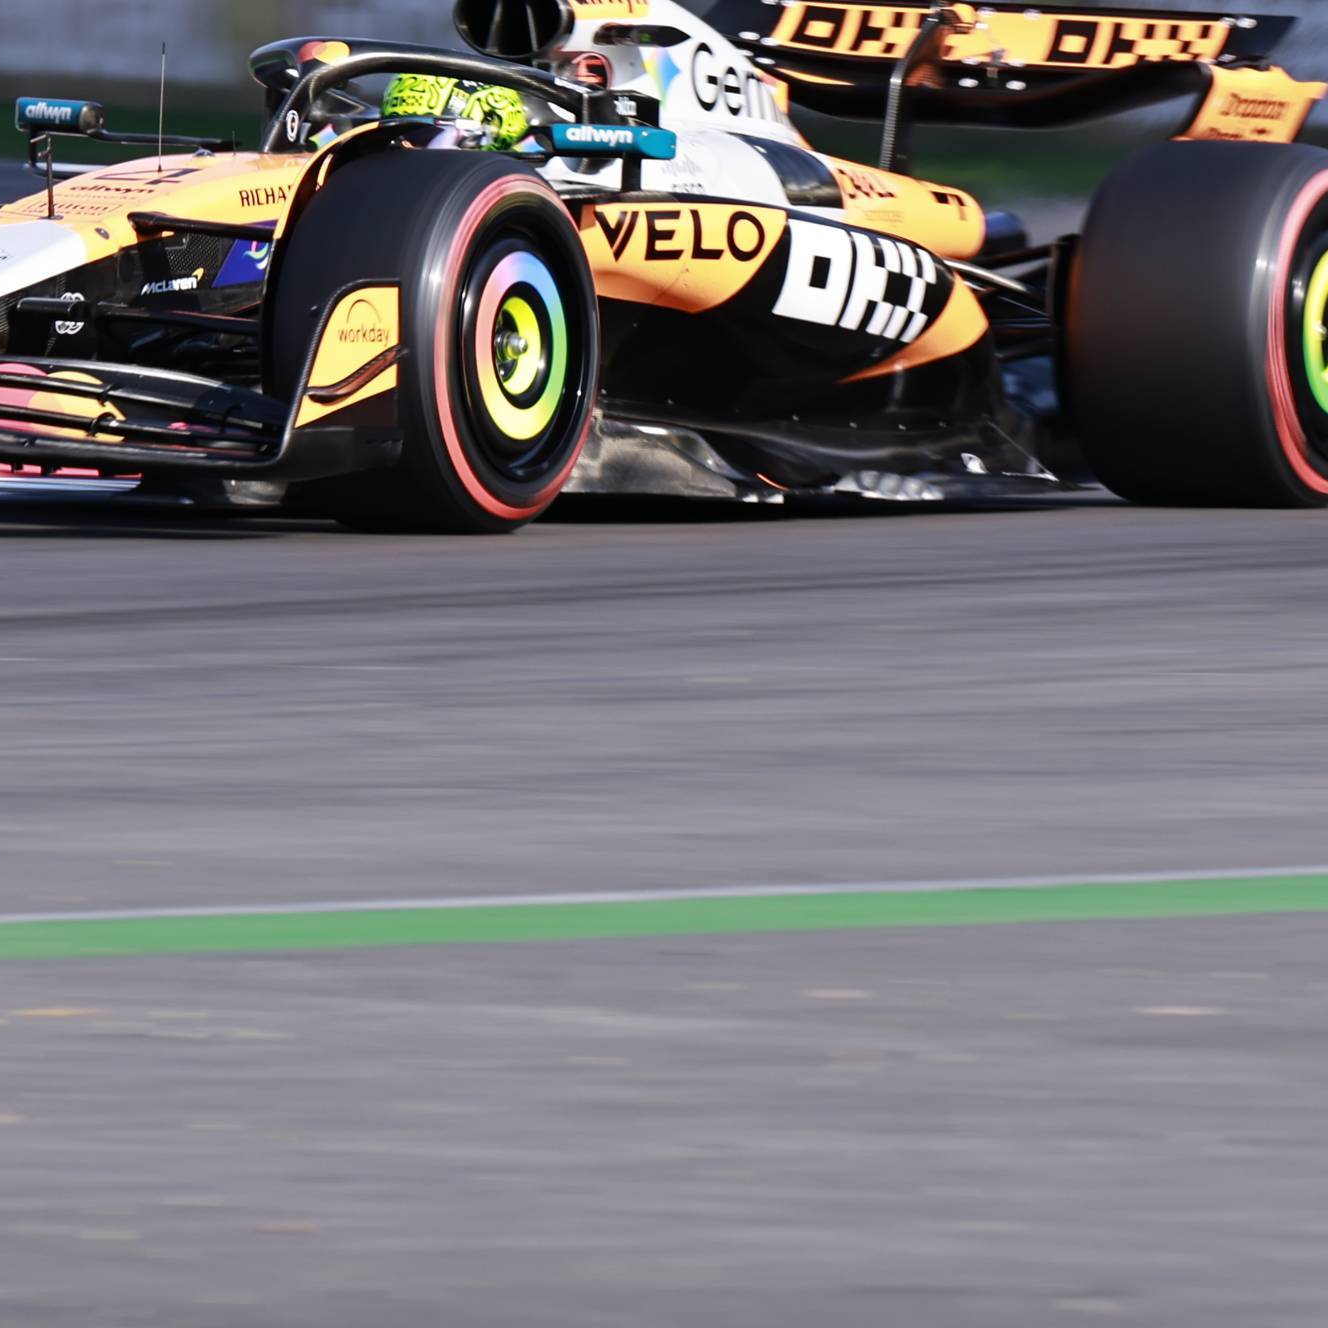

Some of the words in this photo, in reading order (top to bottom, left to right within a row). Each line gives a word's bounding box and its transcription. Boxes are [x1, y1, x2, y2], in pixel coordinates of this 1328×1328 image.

[791, 4, 936, 60] OK
[25, 101, 73, 124] allwyn
[566, 126, 634, 146] allwyn
[238, 184, 292, 208] RICHA
[595, 206, 766, 263] VELO
[141, 276, 198, 295] McLaren
[772, 219, 937, 343] OKX
[338, 323, 390, 348] workday
